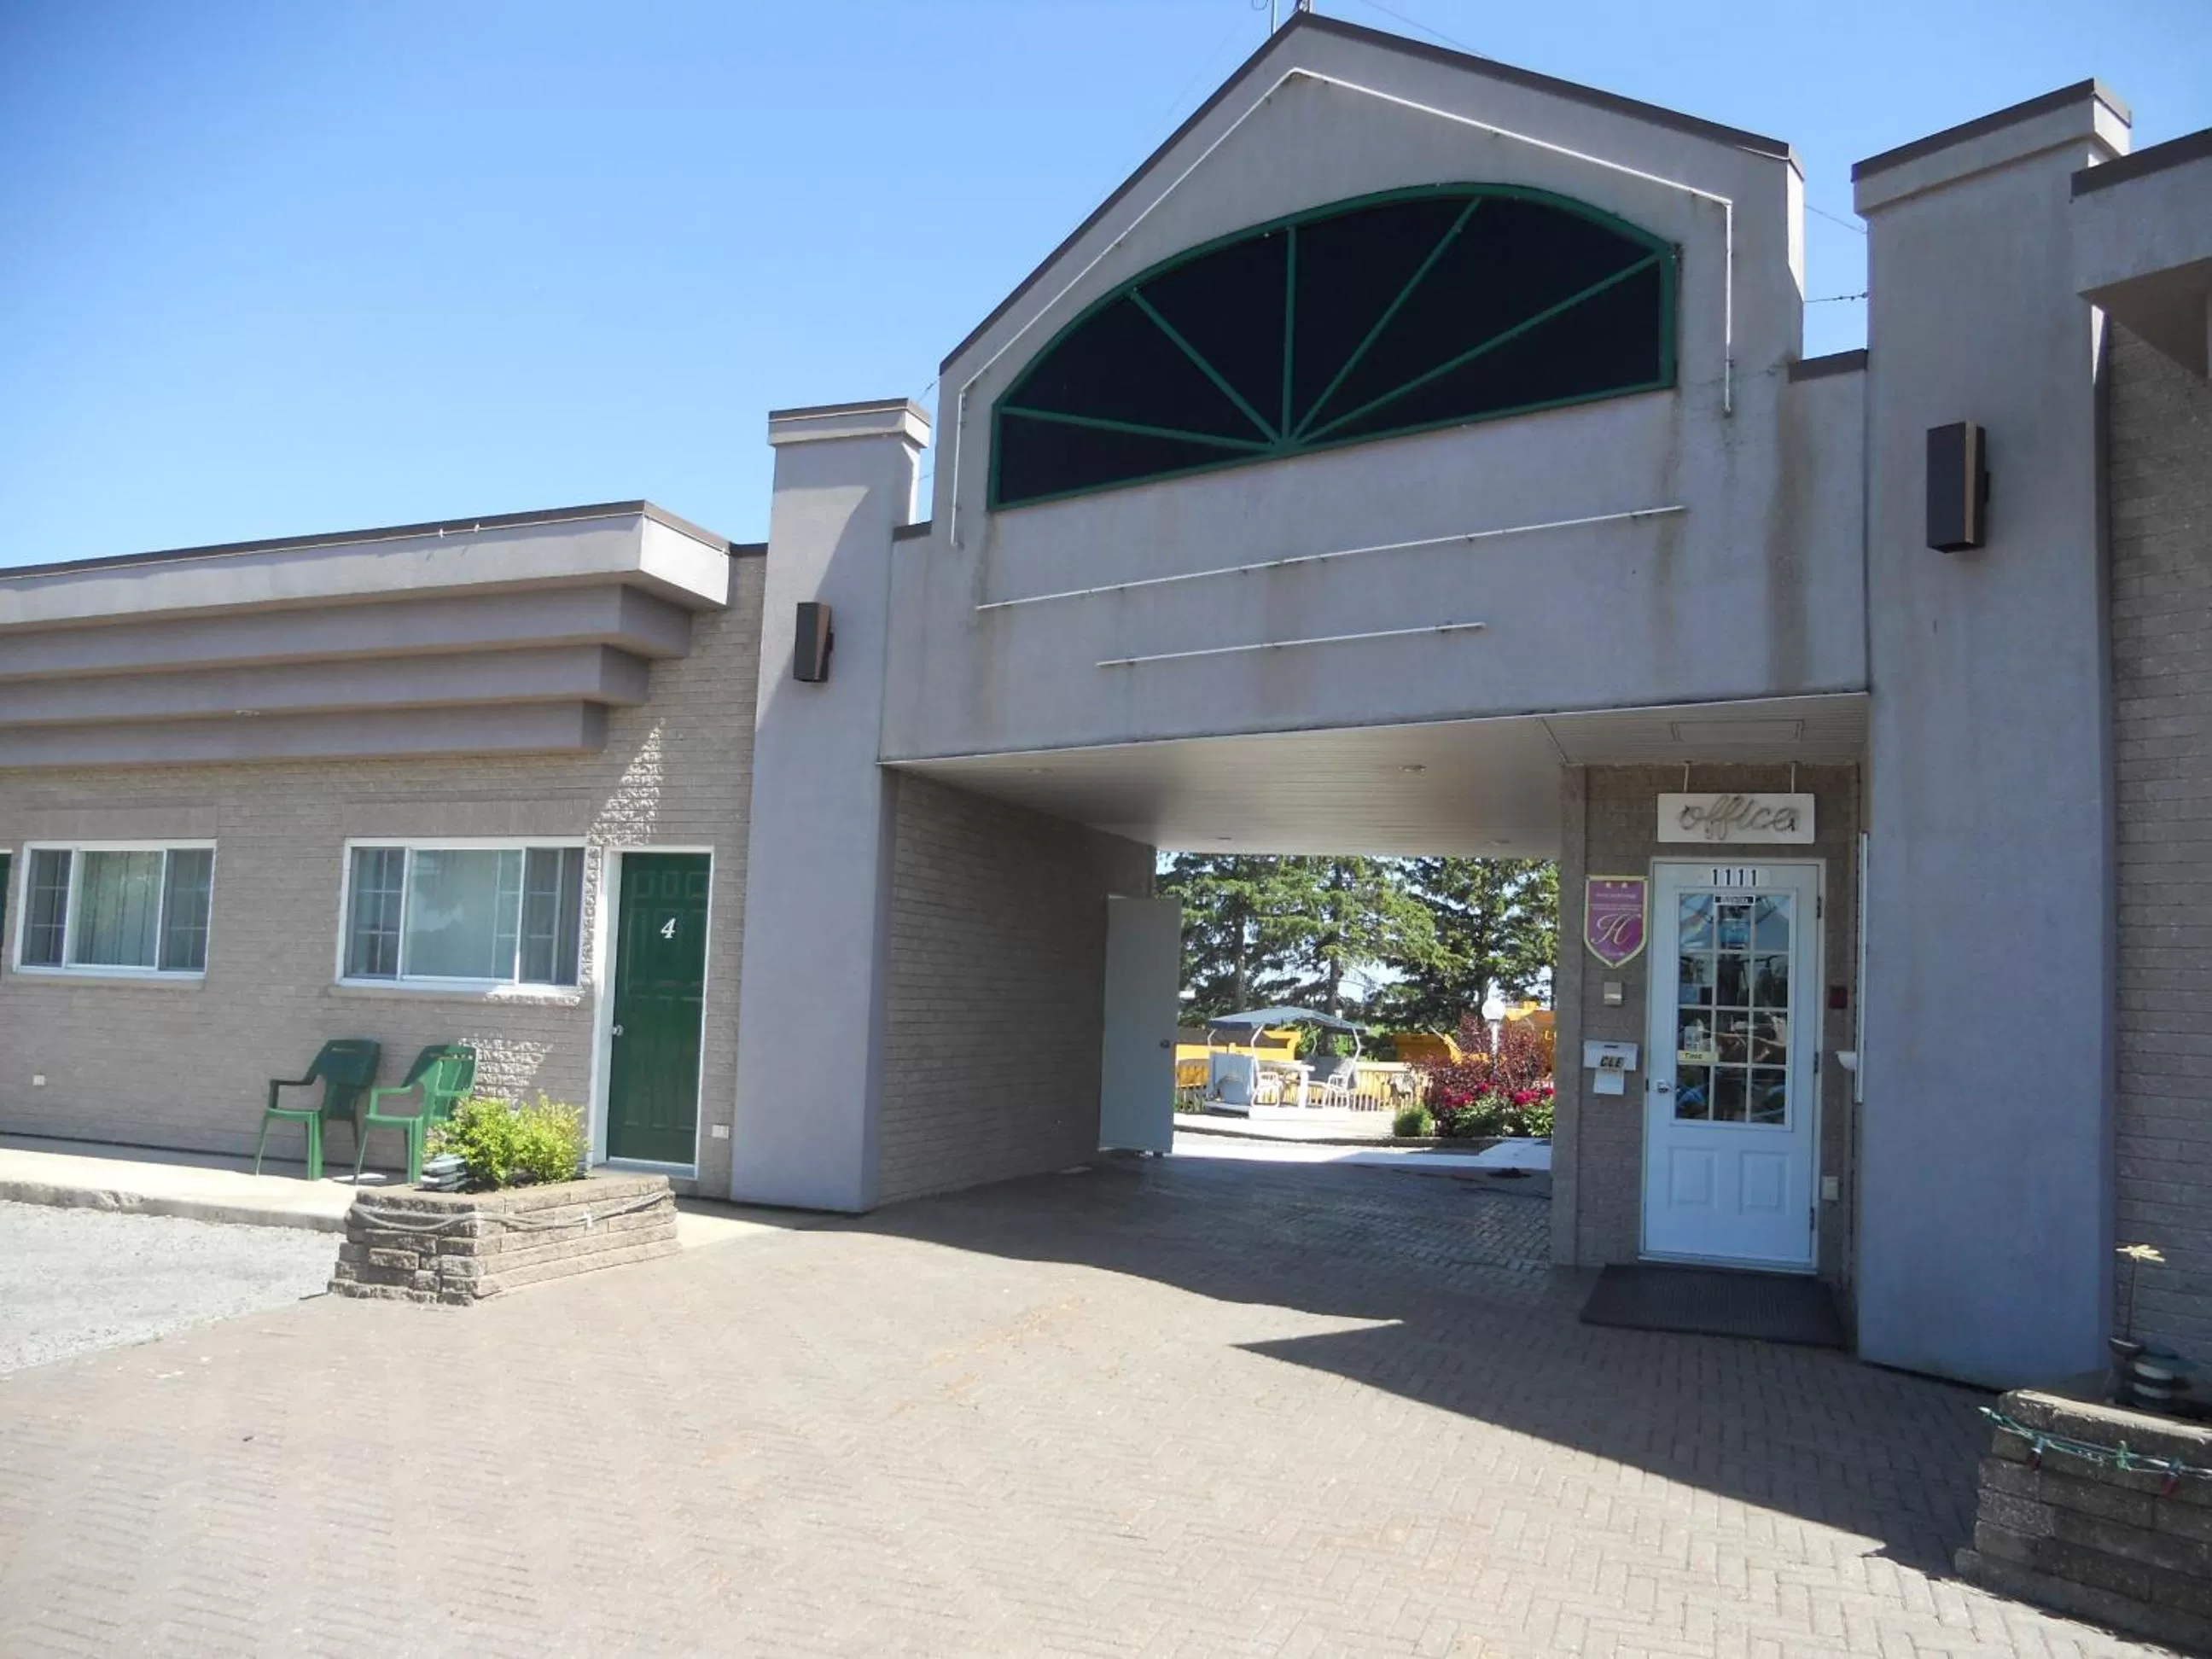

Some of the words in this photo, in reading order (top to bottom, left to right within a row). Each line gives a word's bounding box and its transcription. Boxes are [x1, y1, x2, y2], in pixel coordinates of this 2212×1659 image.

[1679, 795, 1799, 840] office
[1713, 868, 1756, 887] 1111
[661, 917, 676, 939] 4
